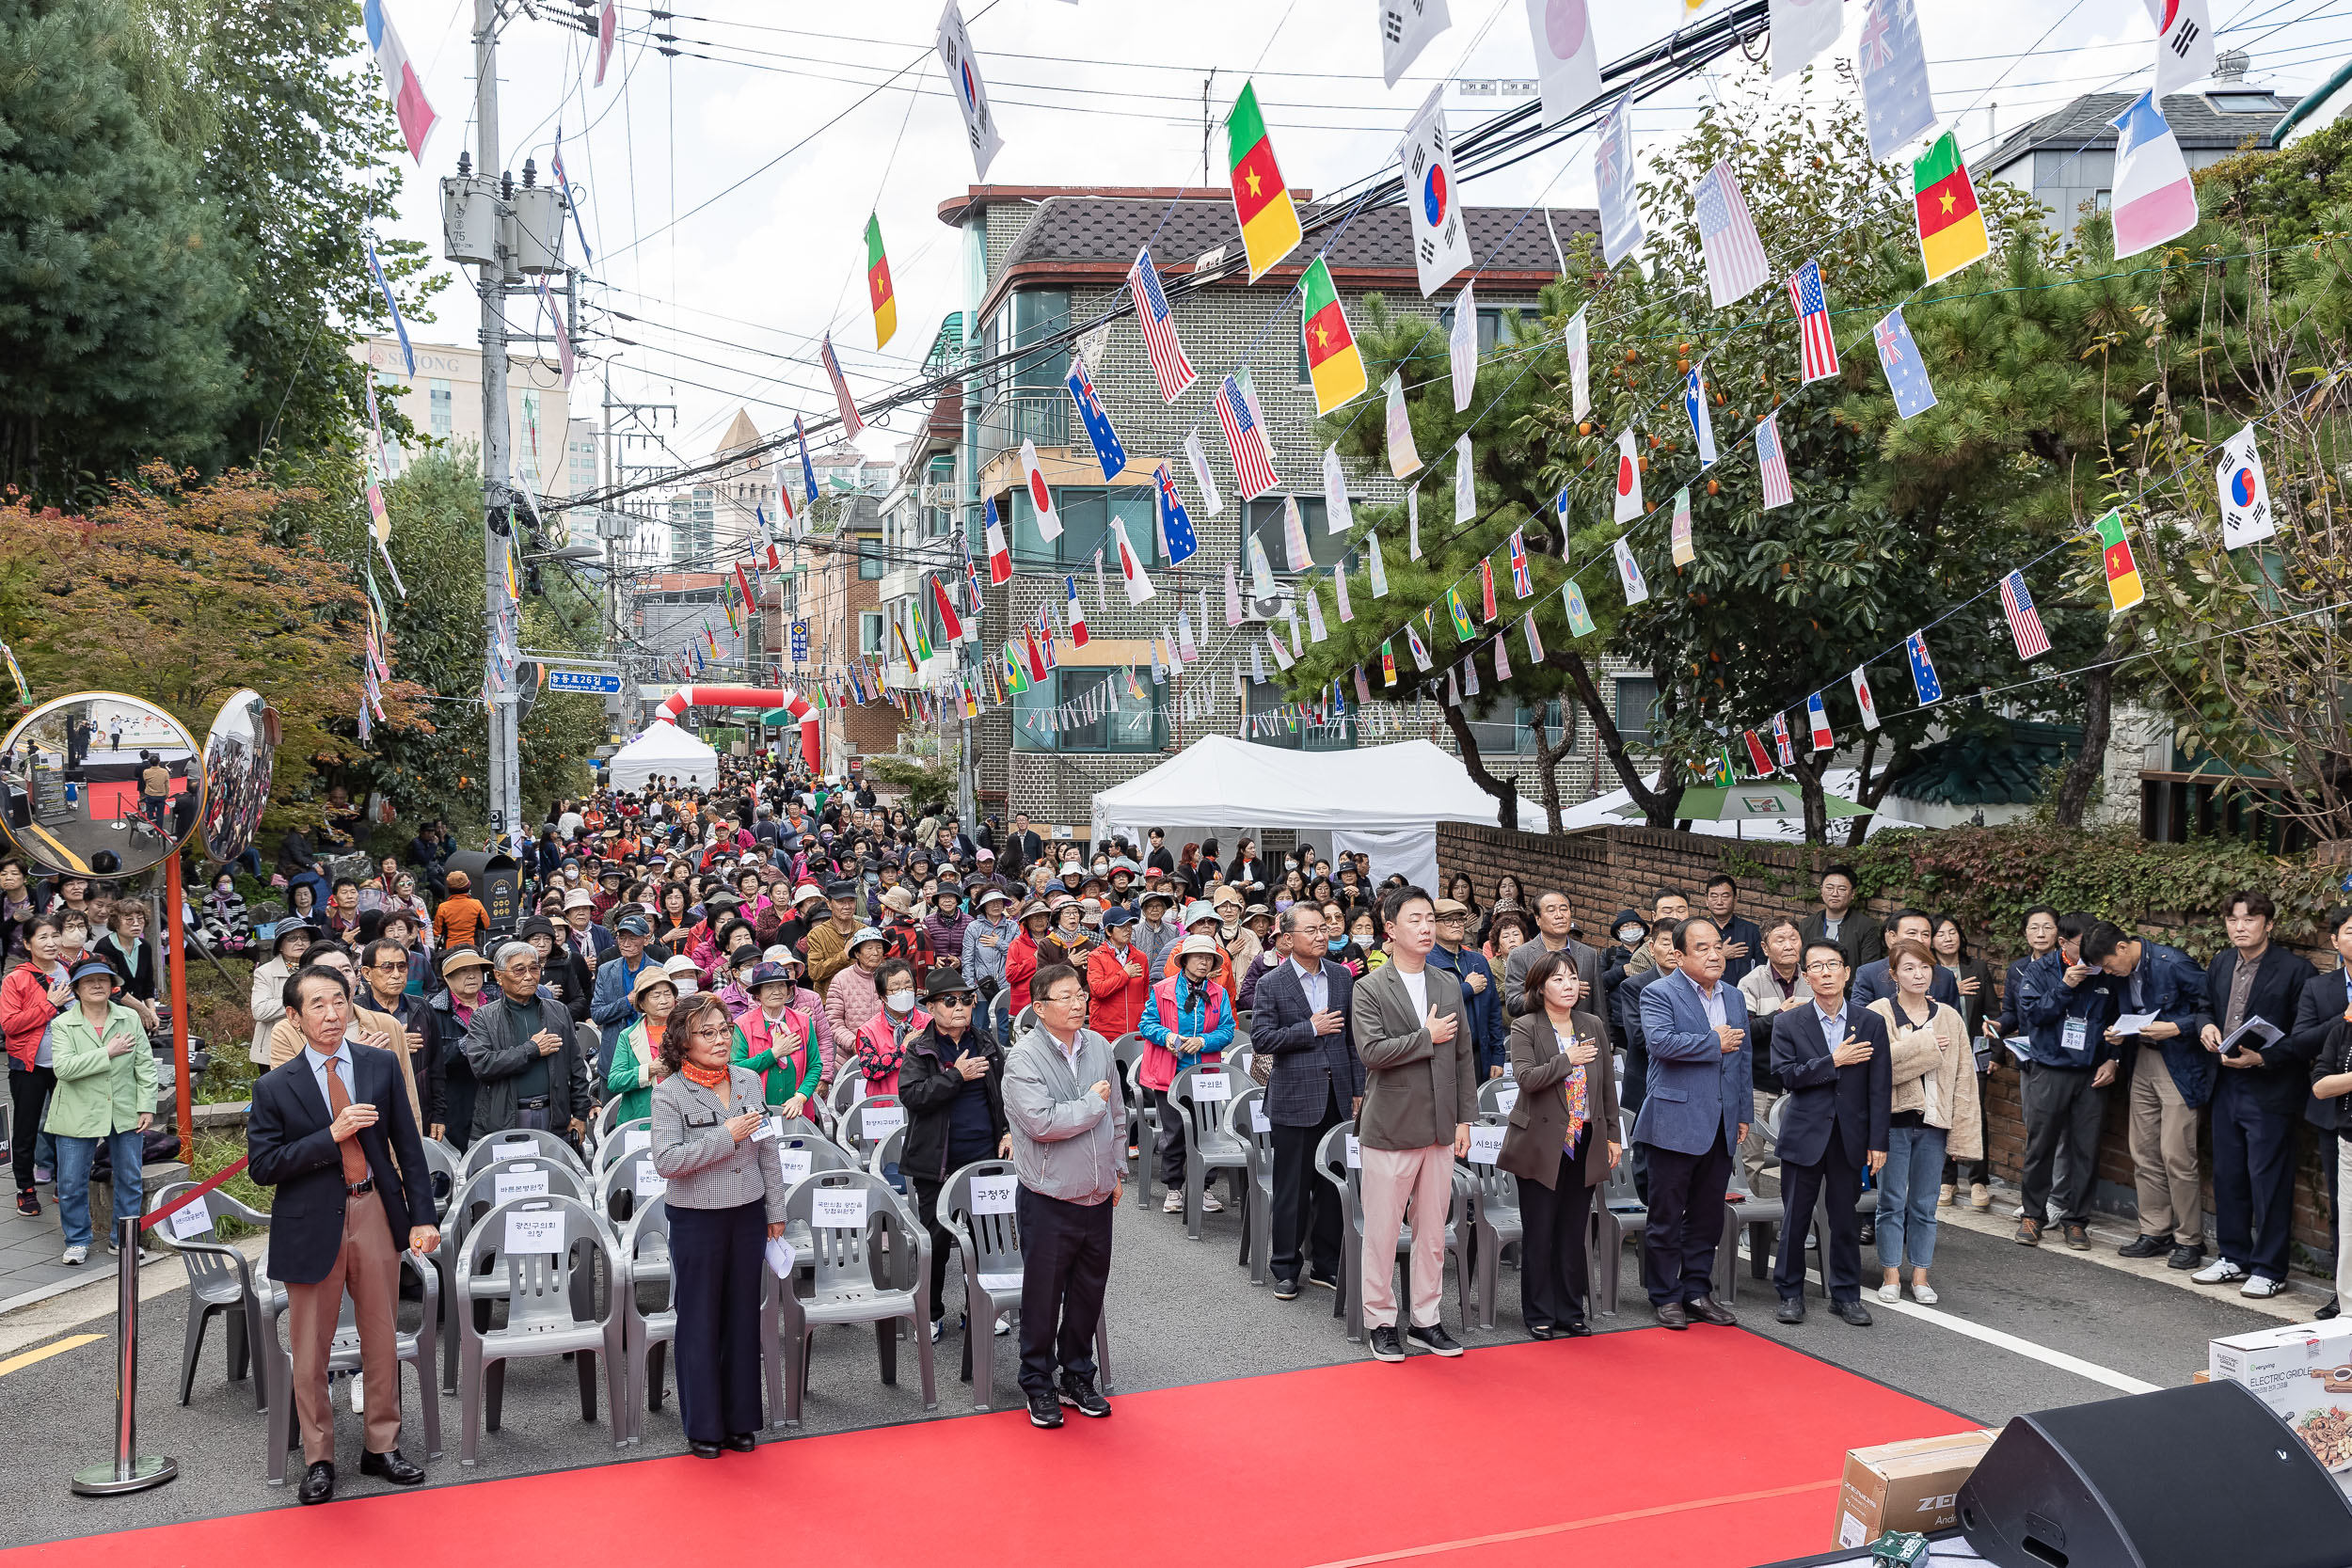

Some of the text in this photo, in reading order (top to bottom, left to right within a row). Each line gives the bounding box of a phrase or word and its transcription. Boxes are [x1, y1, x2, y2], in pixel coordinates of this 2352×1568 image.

[453, 231, 465, 241] 75
[551, 673, 601, 686] 능동로26길
[1199, 1080, 1223, 1089] 구의원
[1475, 1140, 1502, 1149] 시의원
[977, 1189, 1010, 1200] 구청장
[2217, 1353, 2239, 1365] ELECTRIC
[2249, 1371, 2285, 1387] ELECTRIC
[2285, 1366, 2312, 1380] GRIDLE
[1844, 1481, 1877, 1509] ZENOS
